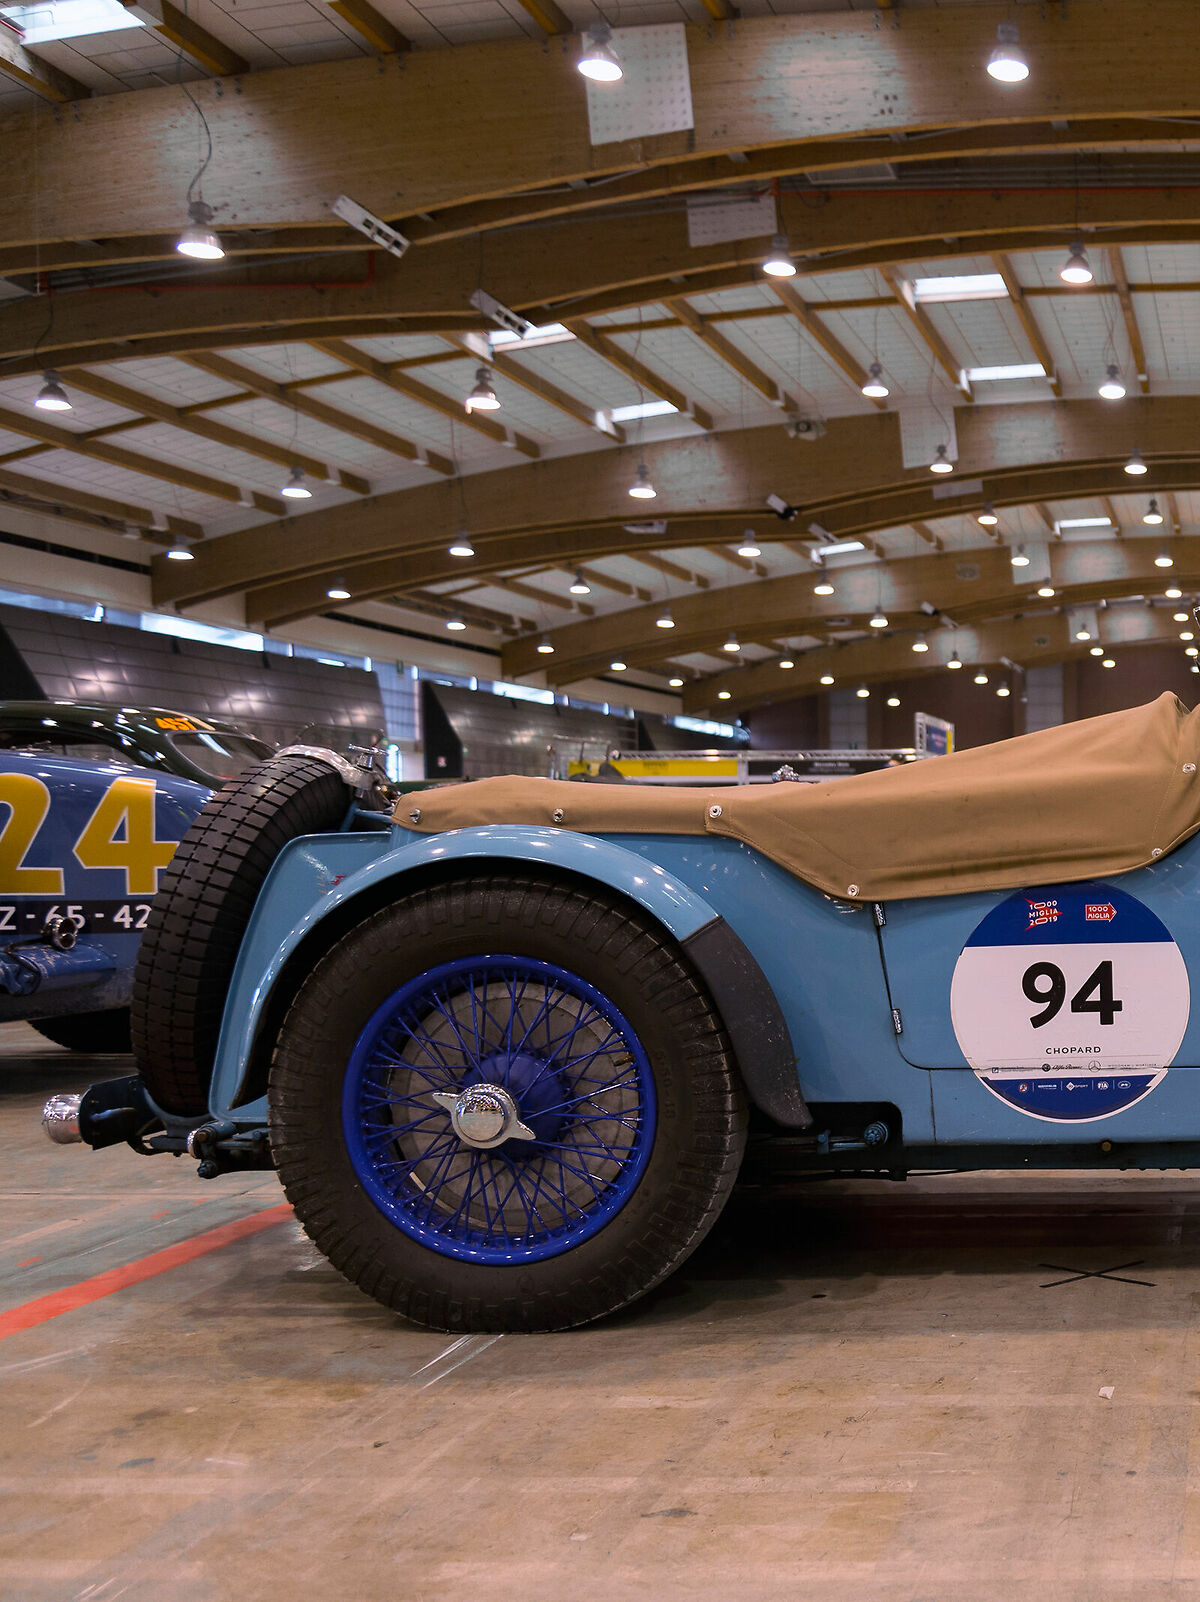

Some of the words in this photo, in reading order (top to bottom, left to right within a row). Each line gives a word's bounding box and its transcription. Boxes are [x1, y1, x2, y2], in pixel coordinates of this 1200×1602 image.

[1029, 900, 1058, 910] 1000
[1028, 908, 1059, 919] MIGLIA
[1029, 916, 1058, 926] 2019
[1021, 960, 1123, 1029] 94
[1045, 1046, 1102, 1055] CHOPARD
